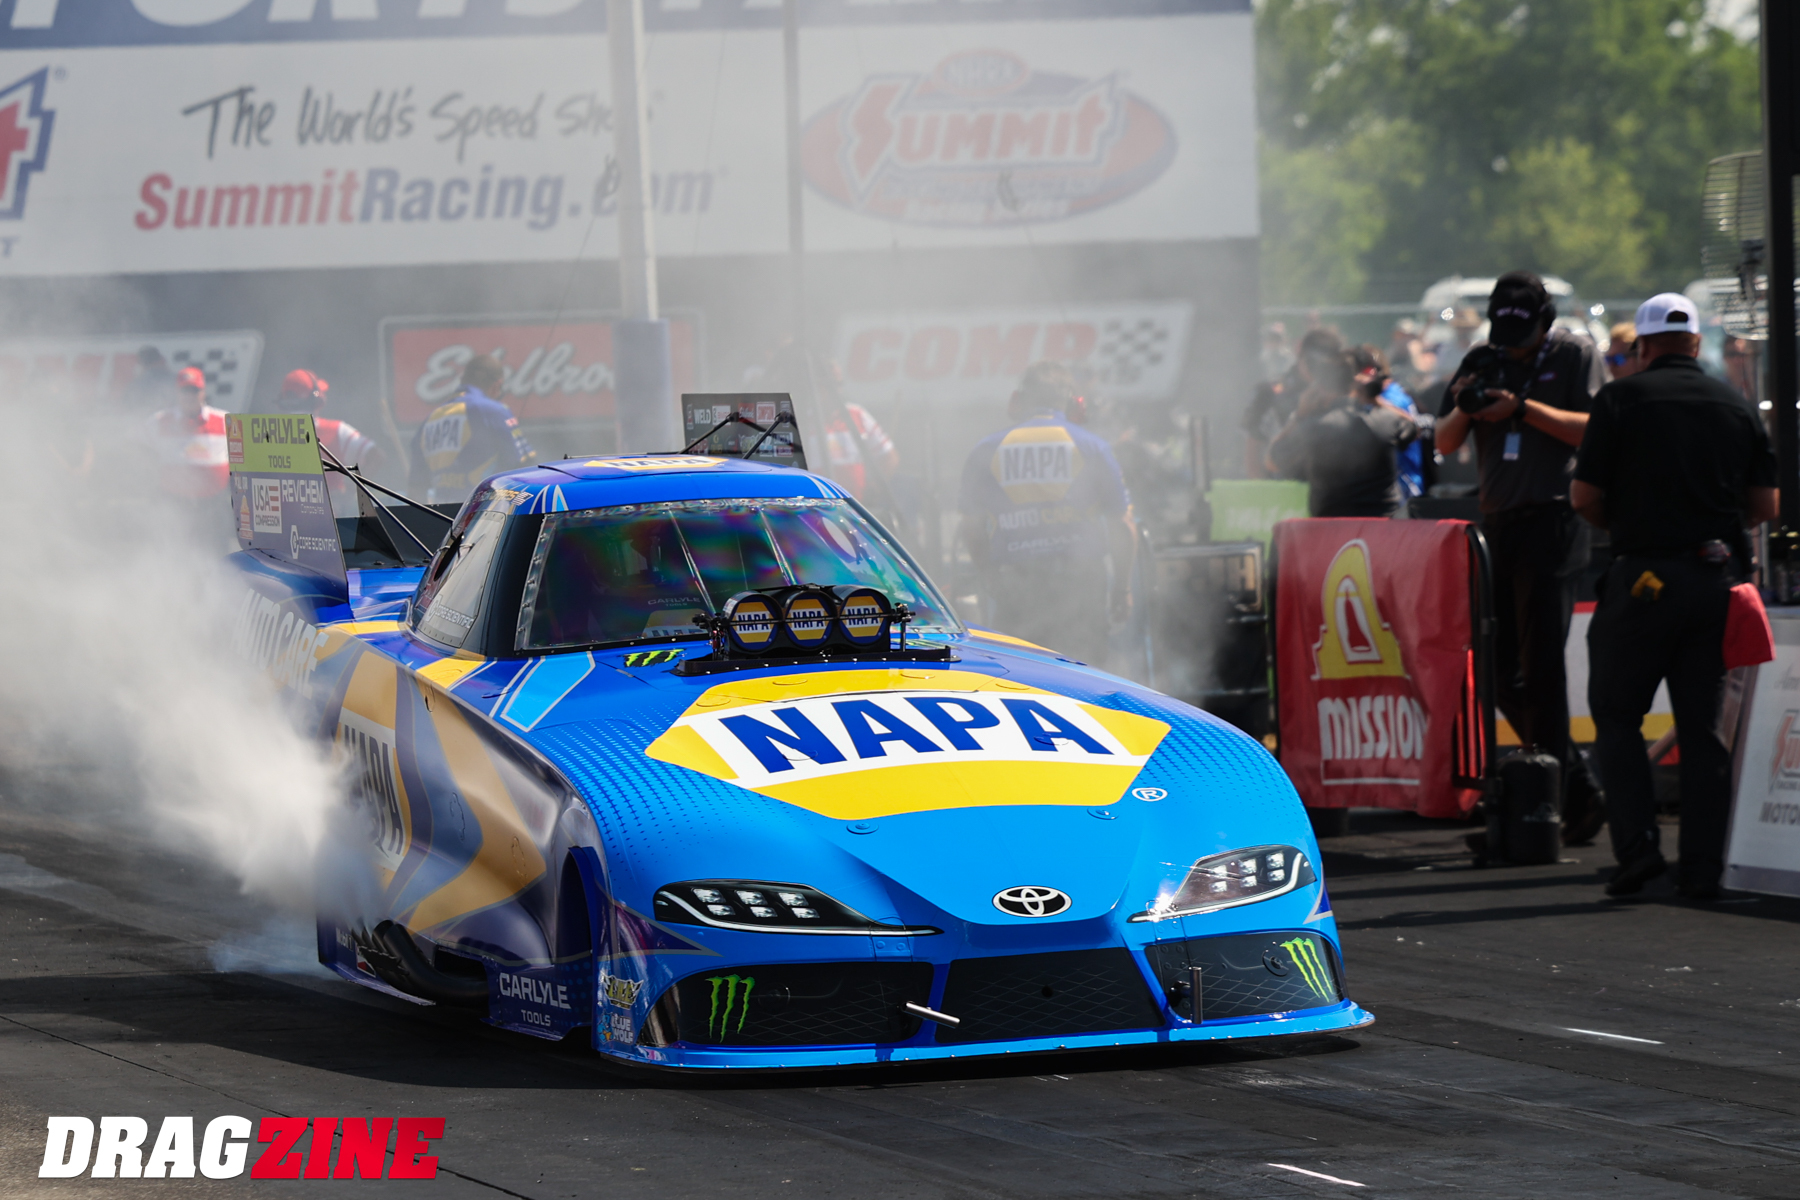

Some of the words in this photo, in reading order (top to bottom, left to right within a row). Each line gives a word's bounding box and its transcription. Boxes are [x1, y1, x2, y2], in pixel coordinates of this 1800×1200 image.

[182, 86, 275, 159] The
[297, 86, 413, 146] World's
[428, 94, 539, 163] Speed
[134, 164, 715, 231] SummitRacing.cm
[251, 417, 306, 444] CARLYLE
[268, 455, 291, 469] TOOLS
[1003, 445, 1069, 481] NAPA
[253, 484, 271, 512] USA
[281, 479, 324, 504] REVCHEM
[255, 514, 280, 528] COMPRESSION
[648, 597, 700, 605] CARLYLE
[738, 613, 769, 631] NAPA
[793, 610, 824, 628] NAPA
[848, 607, 879, 625] NAPA
[719, 697, 1113, 773] NAPA
[1317, 694, 1427, 760] MISSION
[1758, 801, 1800, 824] MOTO
[499, 972, 571, 1010] CARLYLE
[521, 1009, 551, 1027] TOOLS
